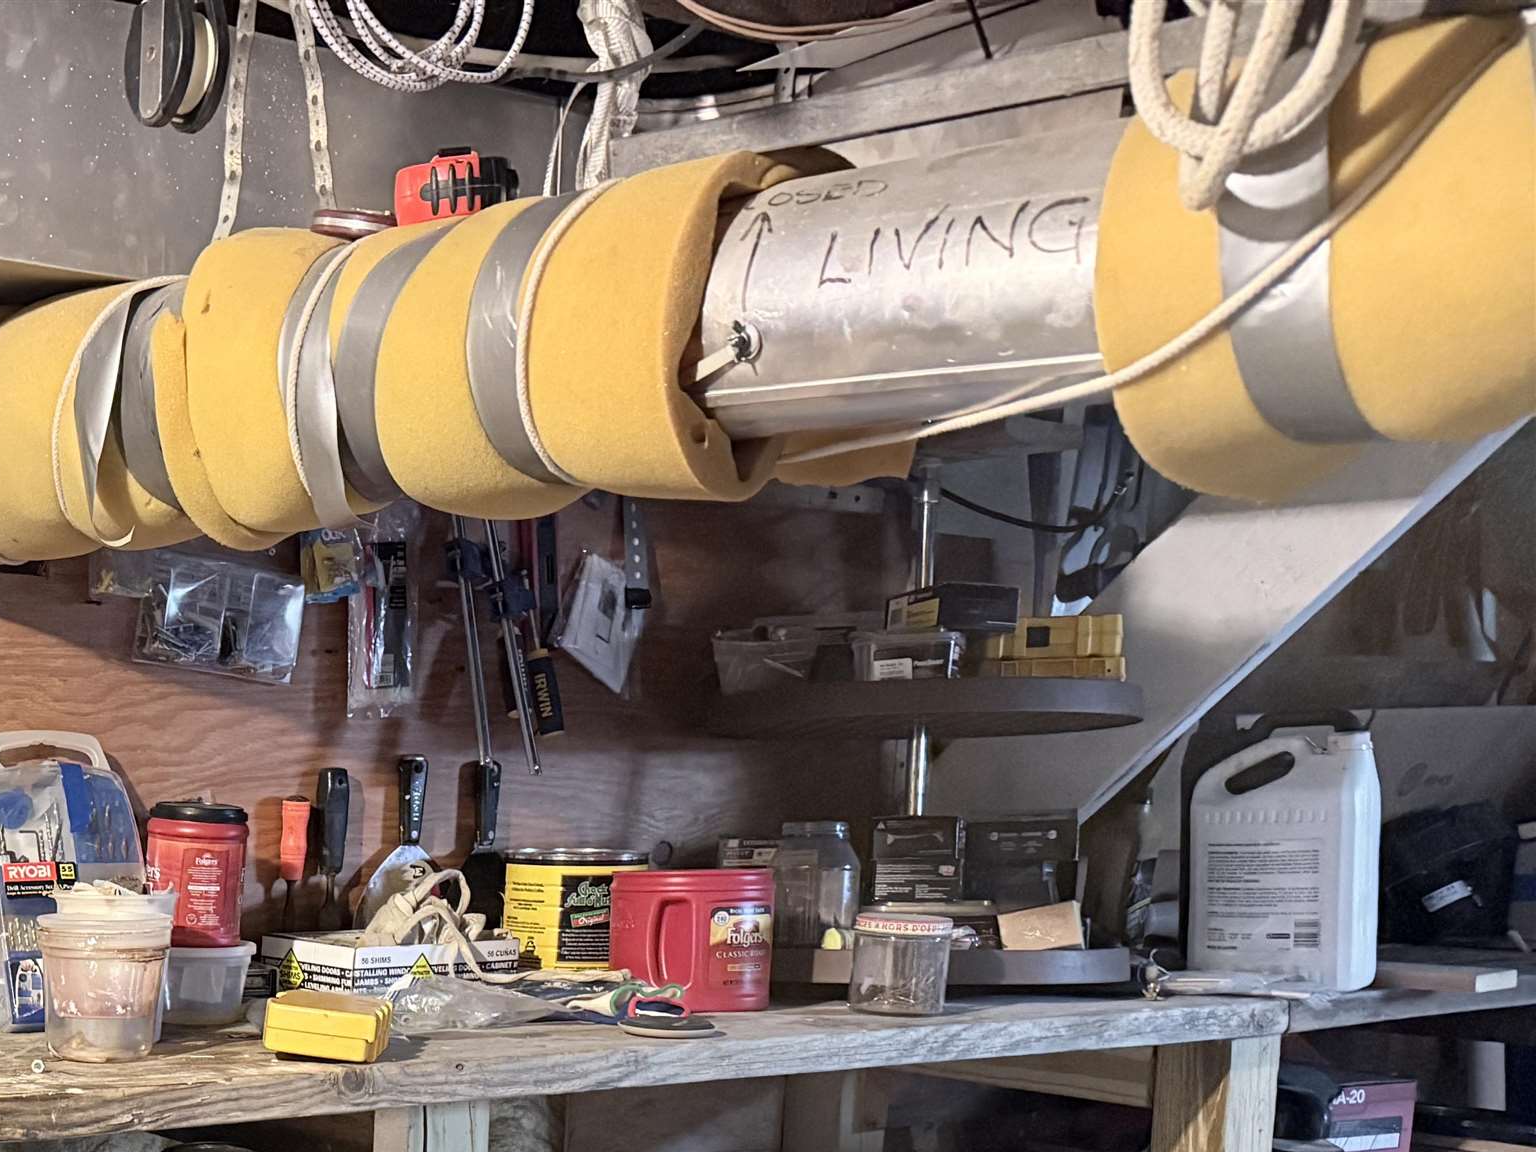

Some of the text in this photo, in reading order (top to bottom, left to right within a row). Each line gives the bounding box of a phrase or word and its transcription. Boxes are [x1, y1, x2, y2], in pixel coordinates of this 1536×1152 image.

[747, 179, 888, 208] OSED
[817, 196, 1091, 288] LIVING
[533, 672, 554, 719] IRWIN
[7, 865, 52, 879] RYOBI
[881, 922, 909, 932] HORS
[370, 956, 392, 965] SHIMS
[715, 950, 750, 959] CLASSIC
[354, 967, 411, 978] STALLING WINDO
